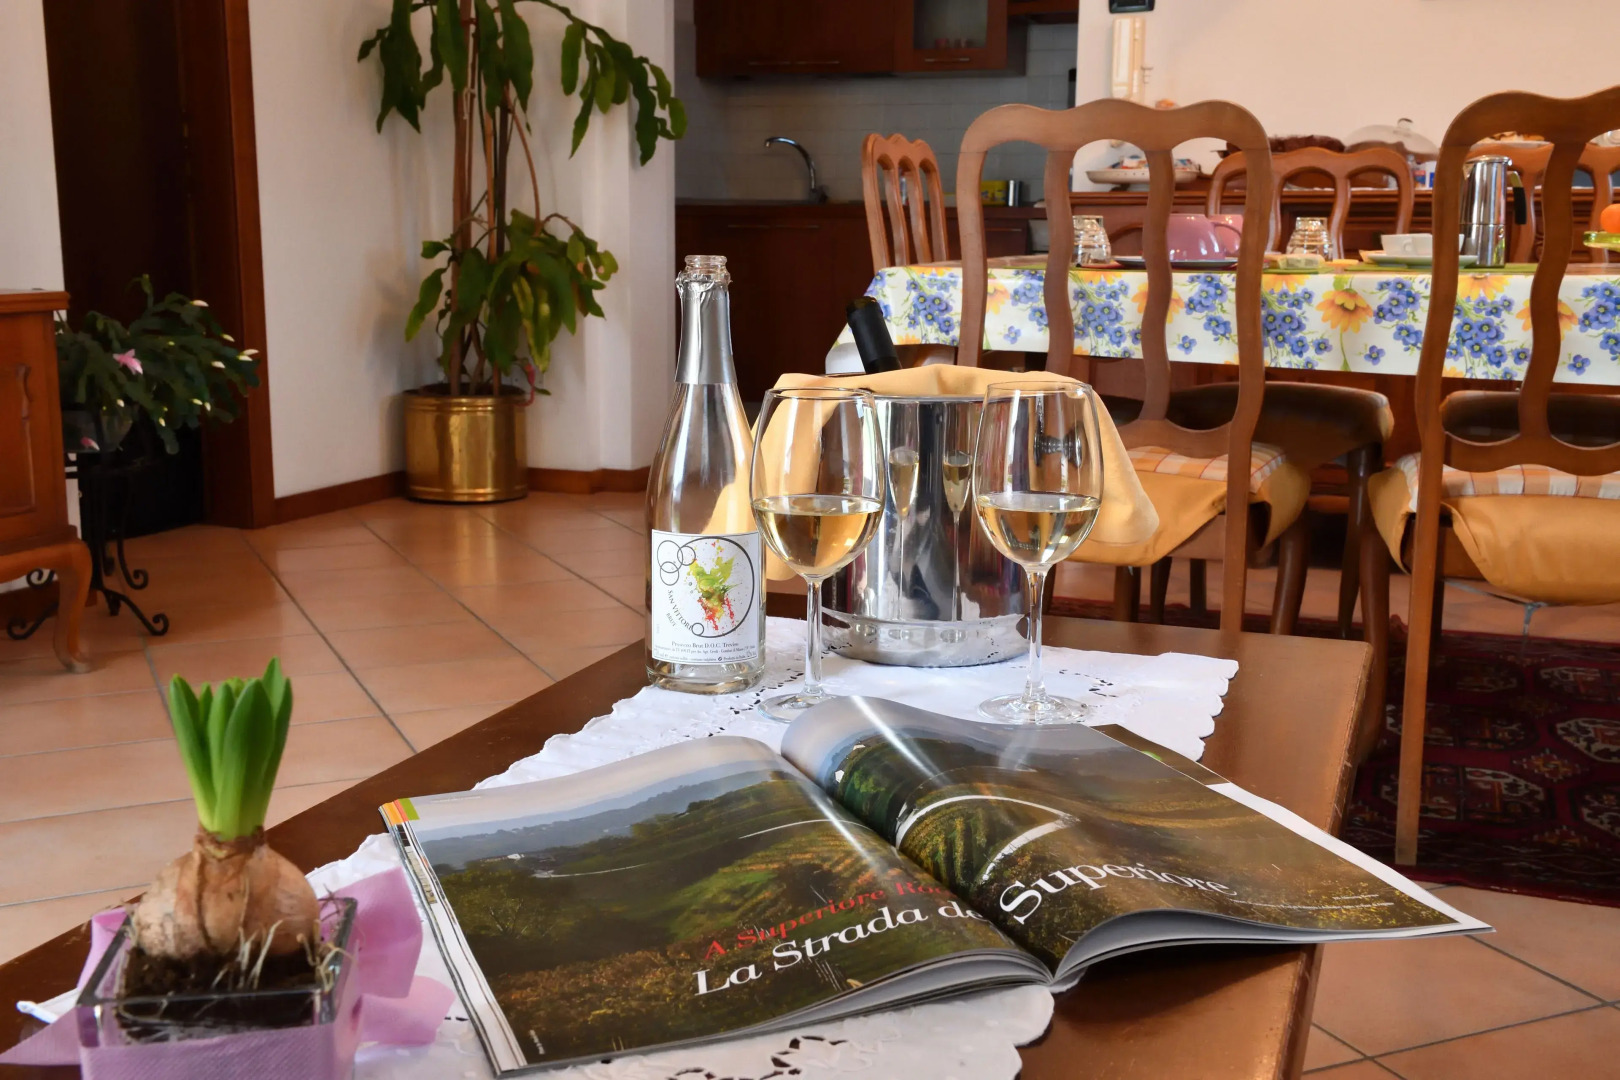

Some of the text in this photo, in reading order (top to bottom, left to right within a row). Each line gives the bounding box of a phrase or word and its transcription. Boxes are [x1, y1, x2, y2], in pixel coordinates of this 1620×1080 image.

[666, 612, 677, 627] BRUT
[667, 589, 675, 604] SAN
[704, 940, 727, 960] A
[737, 888, 887, 949] Superiore
[999, 862, 1238, 926] Superiore
[692, 962, 763, 996] La
[772, 906, 930, 972] Strada
